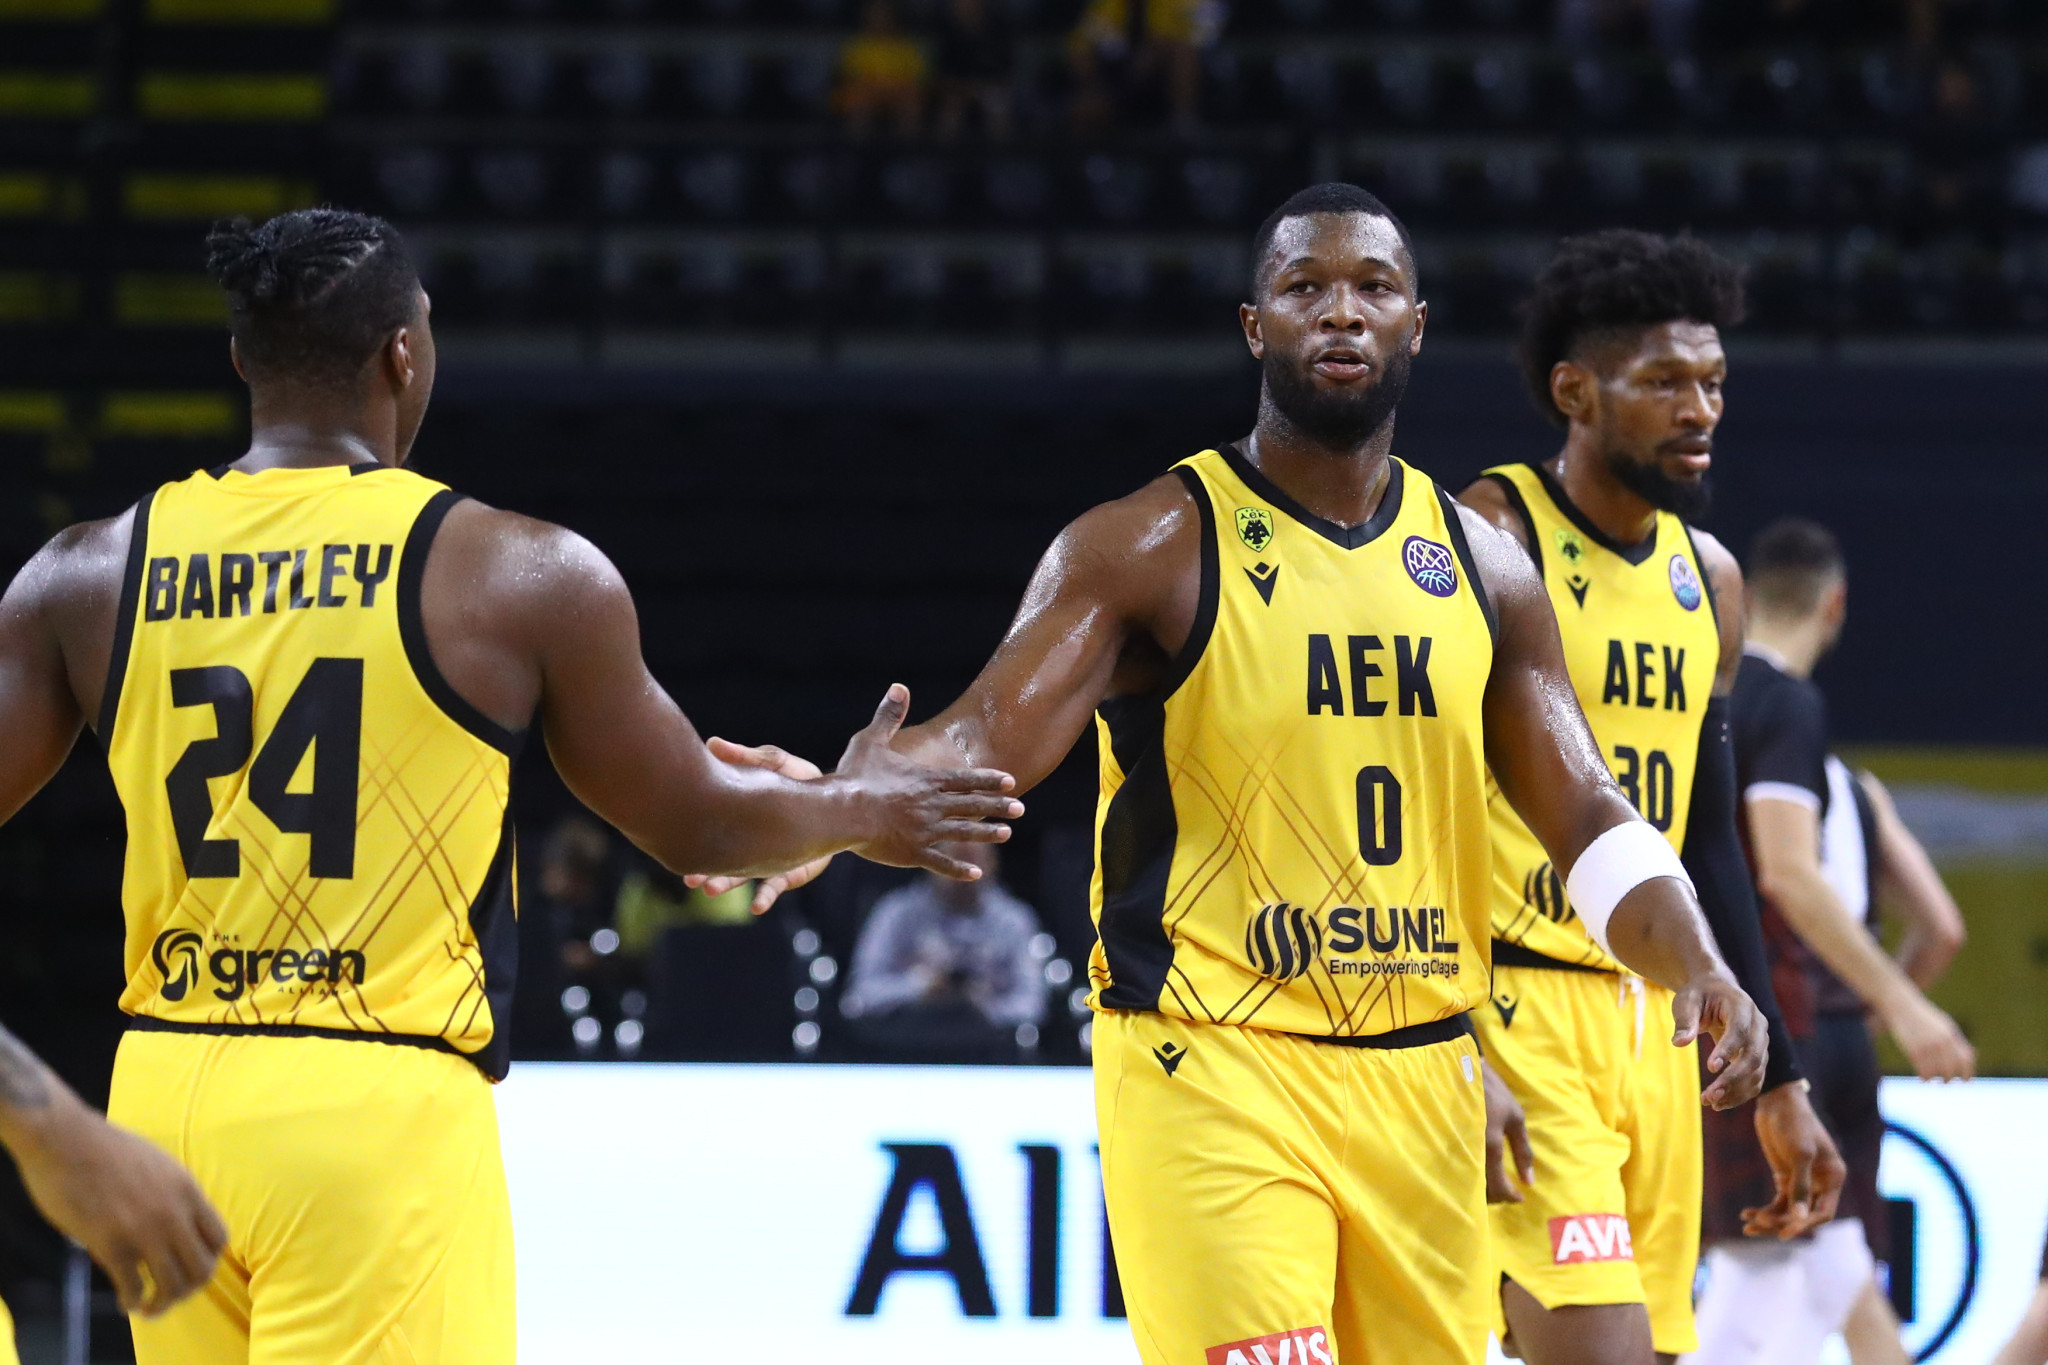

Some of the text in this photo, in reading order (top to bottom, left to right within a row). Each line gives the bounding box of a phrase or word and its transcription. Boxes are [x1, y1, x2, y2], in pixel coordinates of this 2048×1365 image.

[145, 544, 393, 623] BARTLEY
[1307, 634, 1438, 717] AEK
[1602, 639, 1686, 712] AEK
[165, 657, 364, 880] 24
[1614, 745, 1674, 833] 30
[1356, 765, 1402, 866] 0
[213, 934, 239, 942] THE
[1328, 907, 1459, 953] SUNEL
[209, 948, 366, 1001] green
[278, 986, 349, 996] ALLIAN
